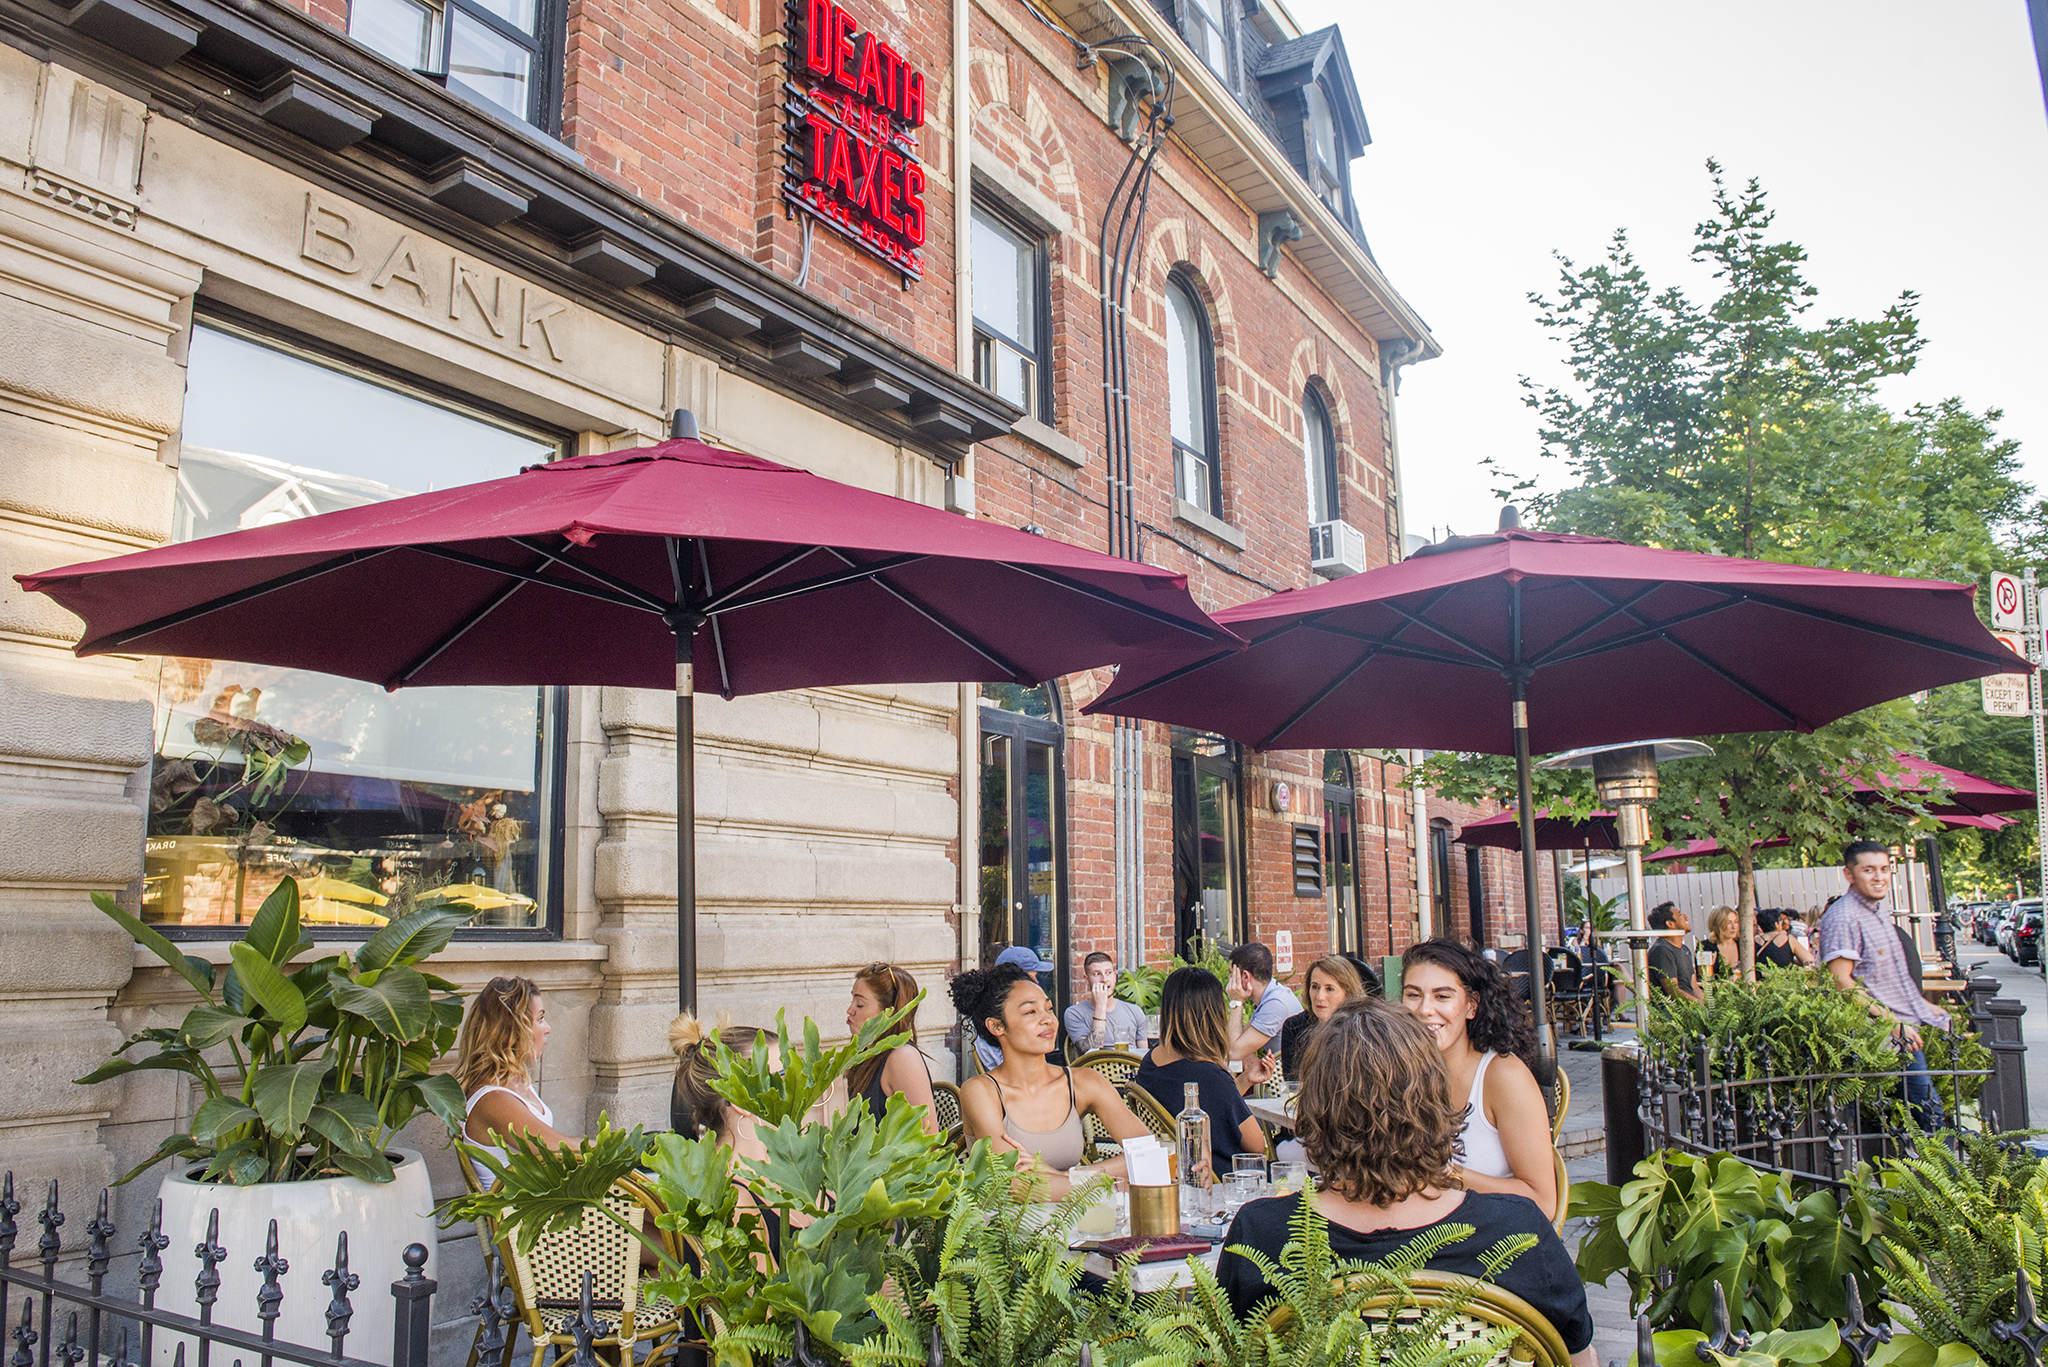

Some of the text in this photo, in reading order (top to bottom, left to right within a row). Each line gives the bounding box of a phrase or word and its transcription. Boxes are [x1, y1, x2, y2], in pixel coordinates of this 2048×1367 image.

[807, 0, 924, 126] DEATH
[841, 94, 890, 145] AND
[803, 182, 851, 228] FREE
[806, 113, 925, 247] TAXES
[862, 220, 925, 275] HOUSE
[300, 191, 567, 363] BANK
[1985, 688, 2024, 701] EXCEPT BY
[1993, 701, 2018, 712] PERMIT
